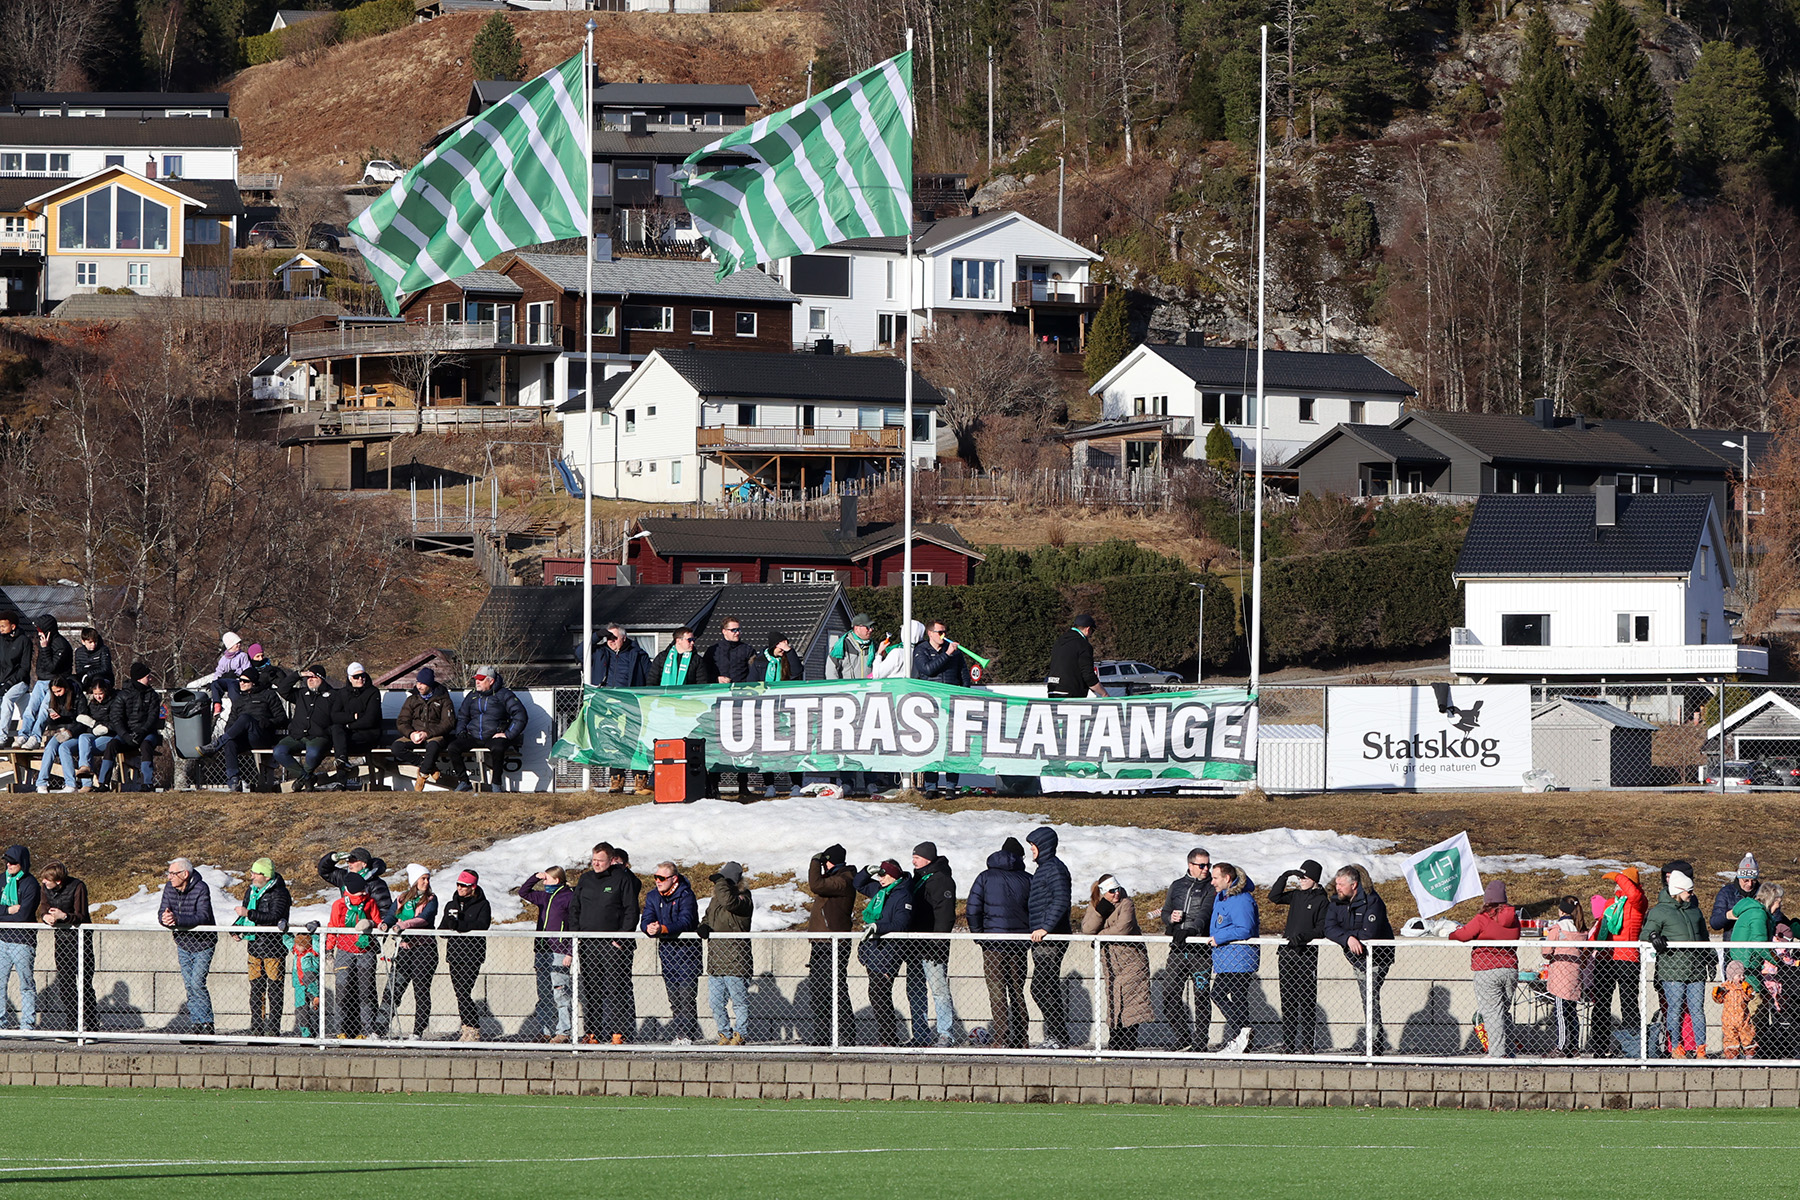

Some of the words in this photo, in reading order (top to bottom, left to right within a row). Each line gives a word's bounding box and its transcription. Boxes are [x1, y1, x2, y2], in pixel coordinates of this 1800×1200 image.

[972, 668, 980, 678] 40
[719, 694, 938, 753] ULTRAS
[1363, 730, 1501, 767] Statskog
[1389, 763, 1399, 773] Vi
[1402, 763, 1416, 775] gir
[1419, 763, 1437, 775] deg
[1440, 763, 1477, 772] naturen
